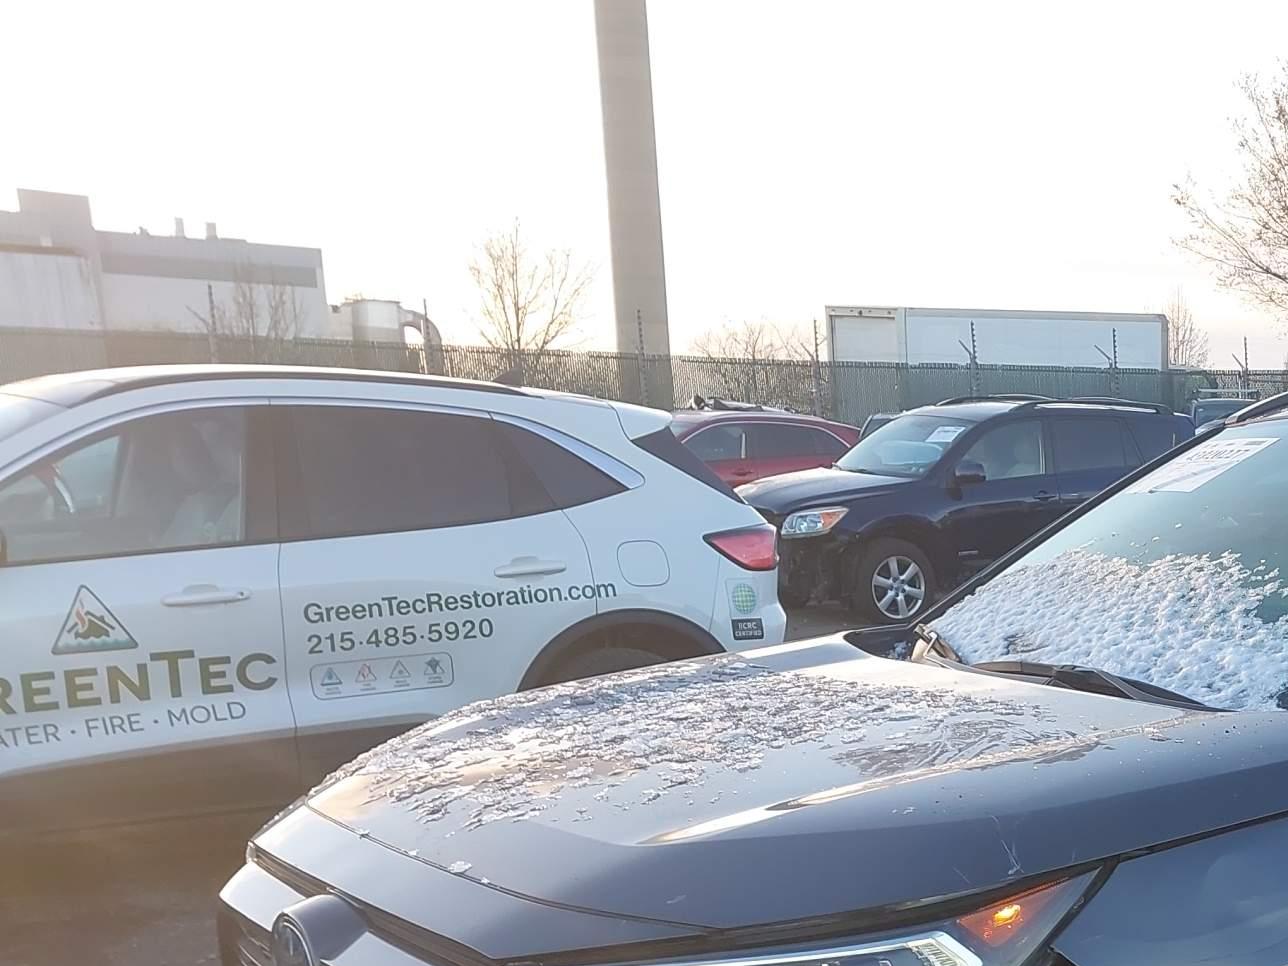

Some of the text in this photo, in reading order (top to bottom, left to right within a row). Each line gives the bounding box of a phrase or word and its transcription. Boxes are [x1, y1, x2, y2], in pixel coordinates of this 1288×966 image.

[304, 581, 617, 624] GreenTecRestoration.com
[85, 713, 145, 738] FIRE
[167, 701, 247, 727] MOLD
